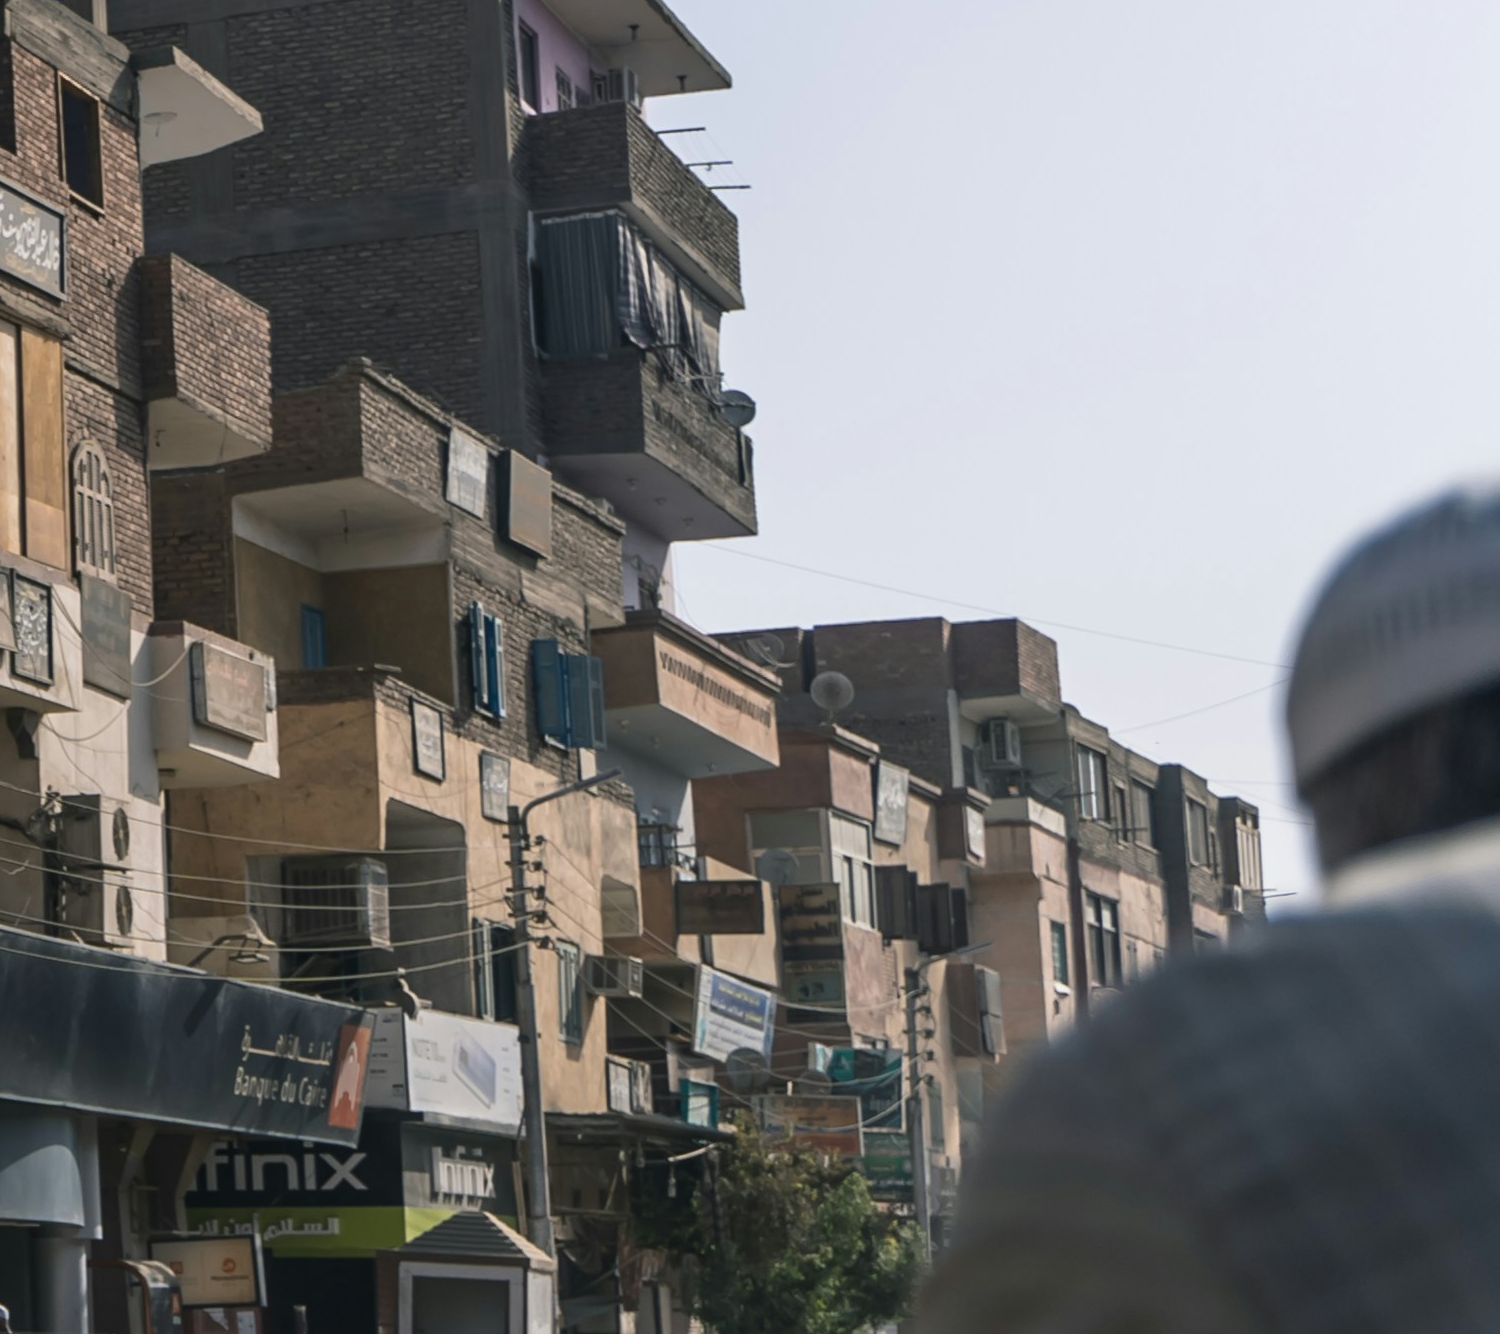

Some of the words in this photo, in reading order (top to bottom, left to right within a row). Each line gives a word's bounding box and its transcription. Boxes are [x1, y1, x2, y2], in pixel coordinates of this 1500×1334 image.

[234, 1065, 278, 1106] Banque
[280, 1073, 298, 1104] du
[298, 1076, 328, 1108] Caire
